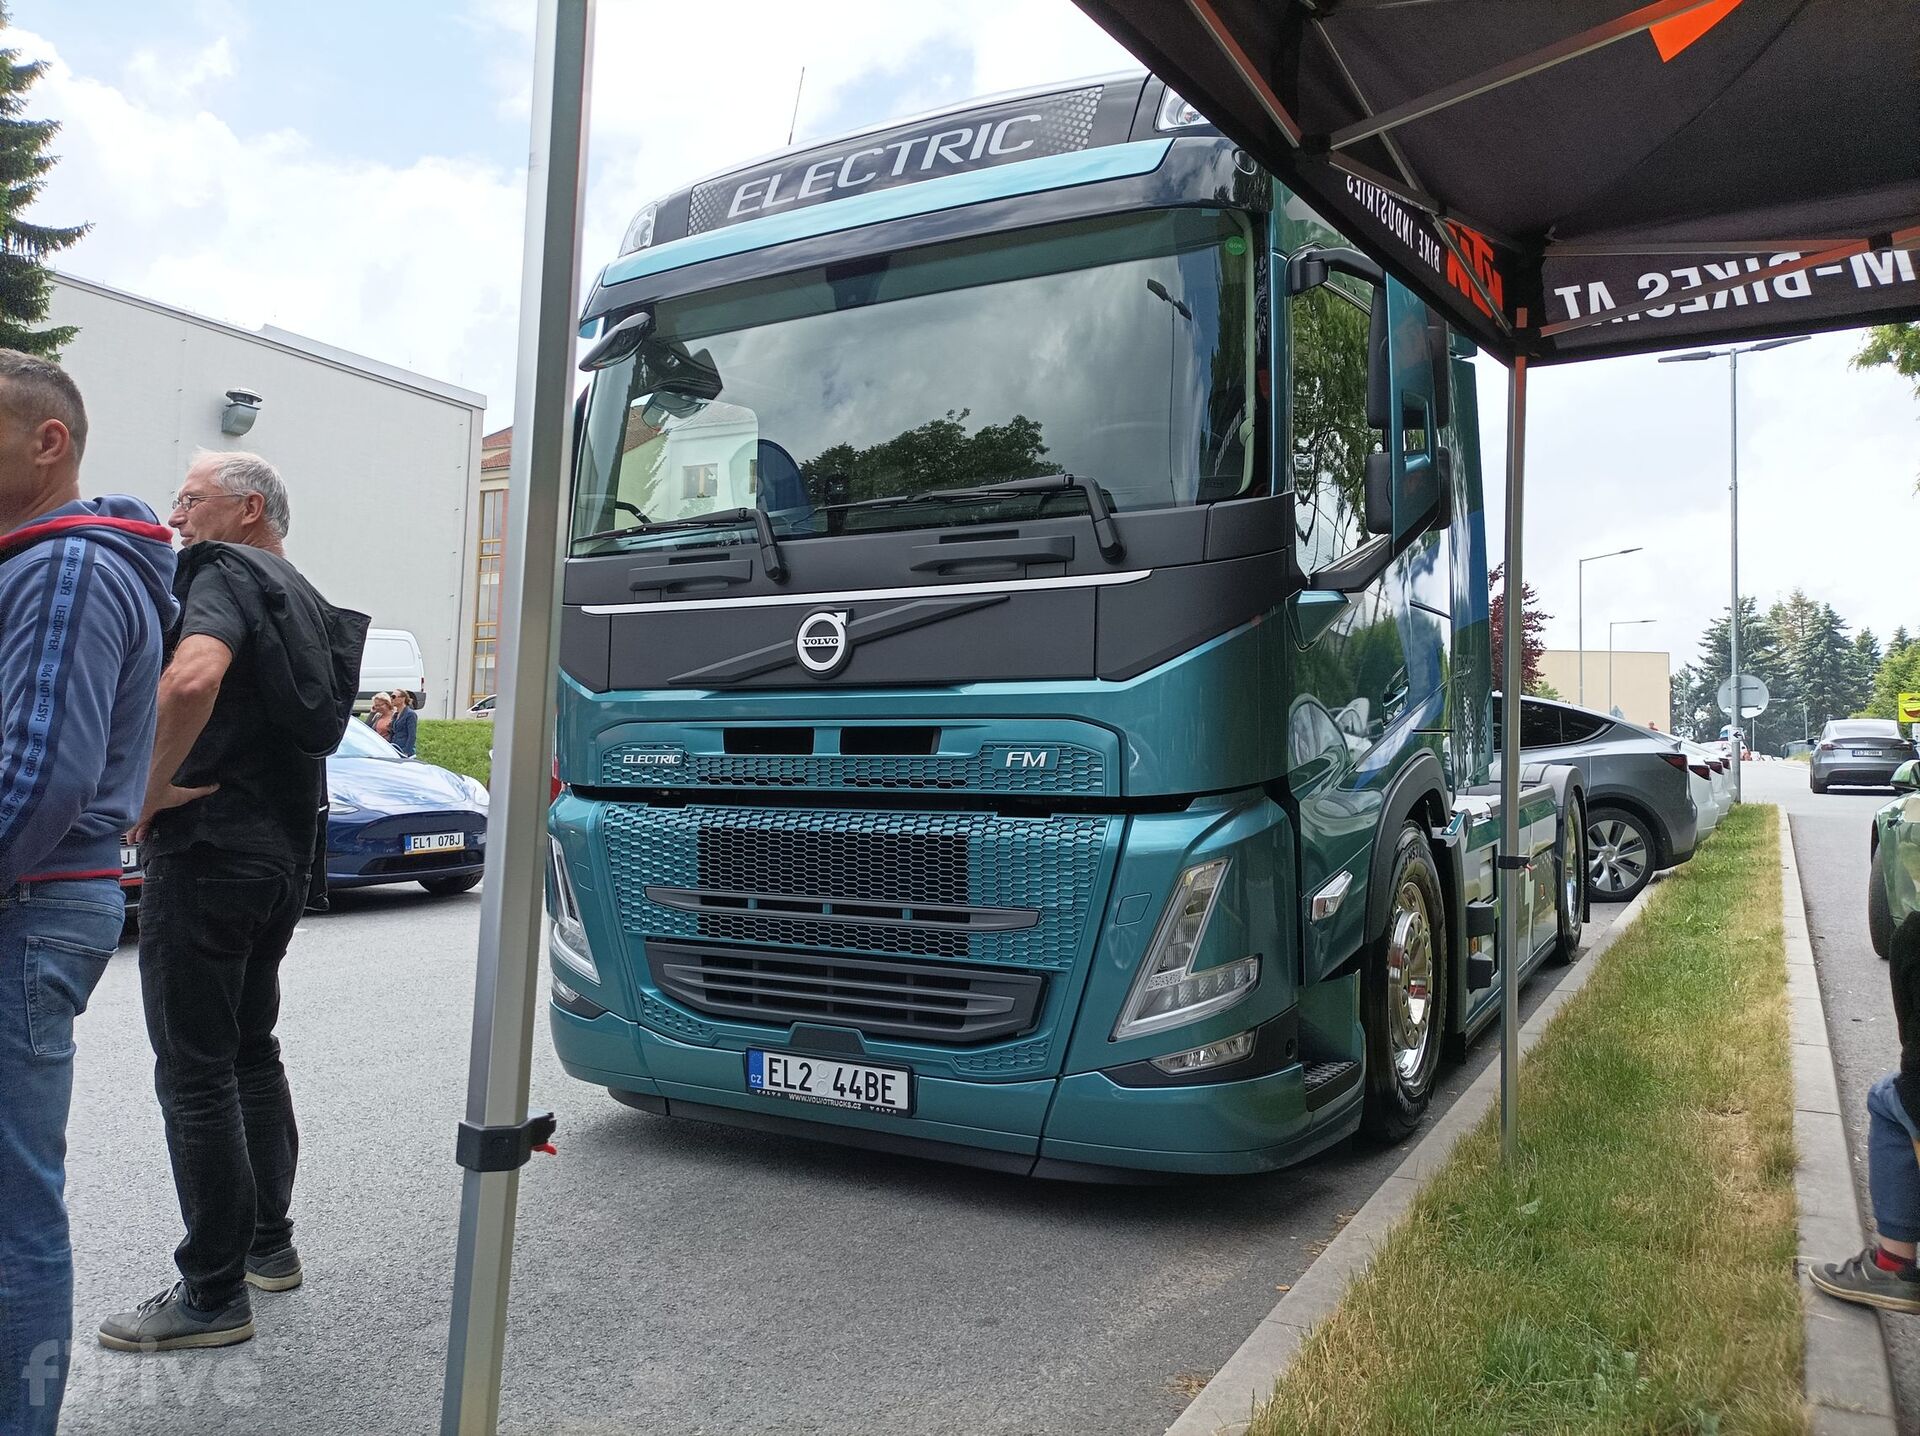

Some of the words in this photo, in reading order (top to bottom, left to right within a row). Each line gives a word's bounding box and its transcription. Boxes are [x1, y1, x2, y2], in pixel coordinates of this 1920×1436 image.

[726, 113, 1042, 219] ELECTRIC
[802, 637, 839, 645] VOLVO
[622, 754, 681, 764] ELECTRIC
[1005, 751, 1048, 768] FM
[413, 836, 431, 849] EL1
[438, 834, 461, 847] 07BJ
[750, 1073, 762, 1084] CZ
[768, 1057, 813, 1092] EL2
[832, 1066, 896, 1105] 44BE
